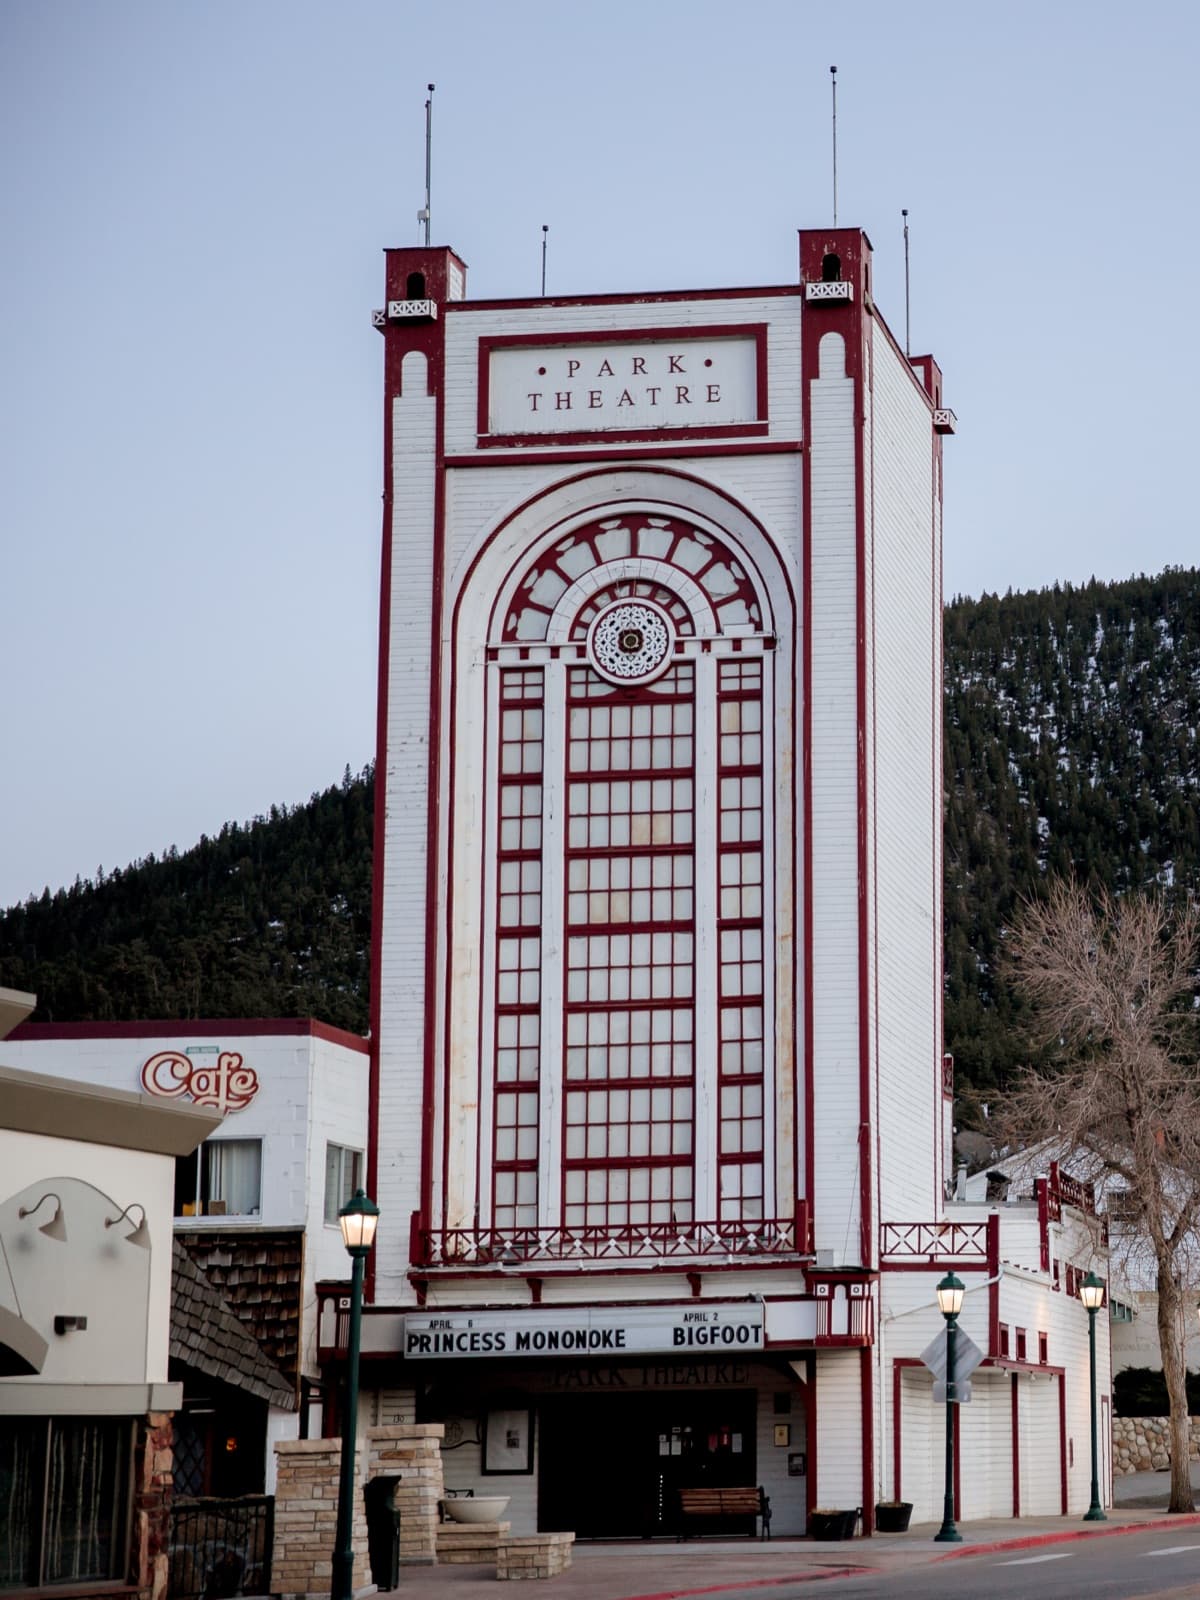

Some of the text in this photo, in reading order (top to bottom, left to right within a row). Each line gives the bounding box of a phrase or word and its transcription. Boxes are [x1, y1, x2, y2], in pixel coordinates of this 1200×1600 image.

[567, 355, 686, 378] PARK
[527, 384, 721, 411] THEATRE
[141, 1051, 259, 1115] Cafe
[429, 1319, 473, 1330] APRIL 6
[683, 1312, 719, 1322] APRIL 2
[407, 1329, 626, 1353] PRINCESS MONONOKE
[673, 1324, 762, 1346] BIGFOOT
